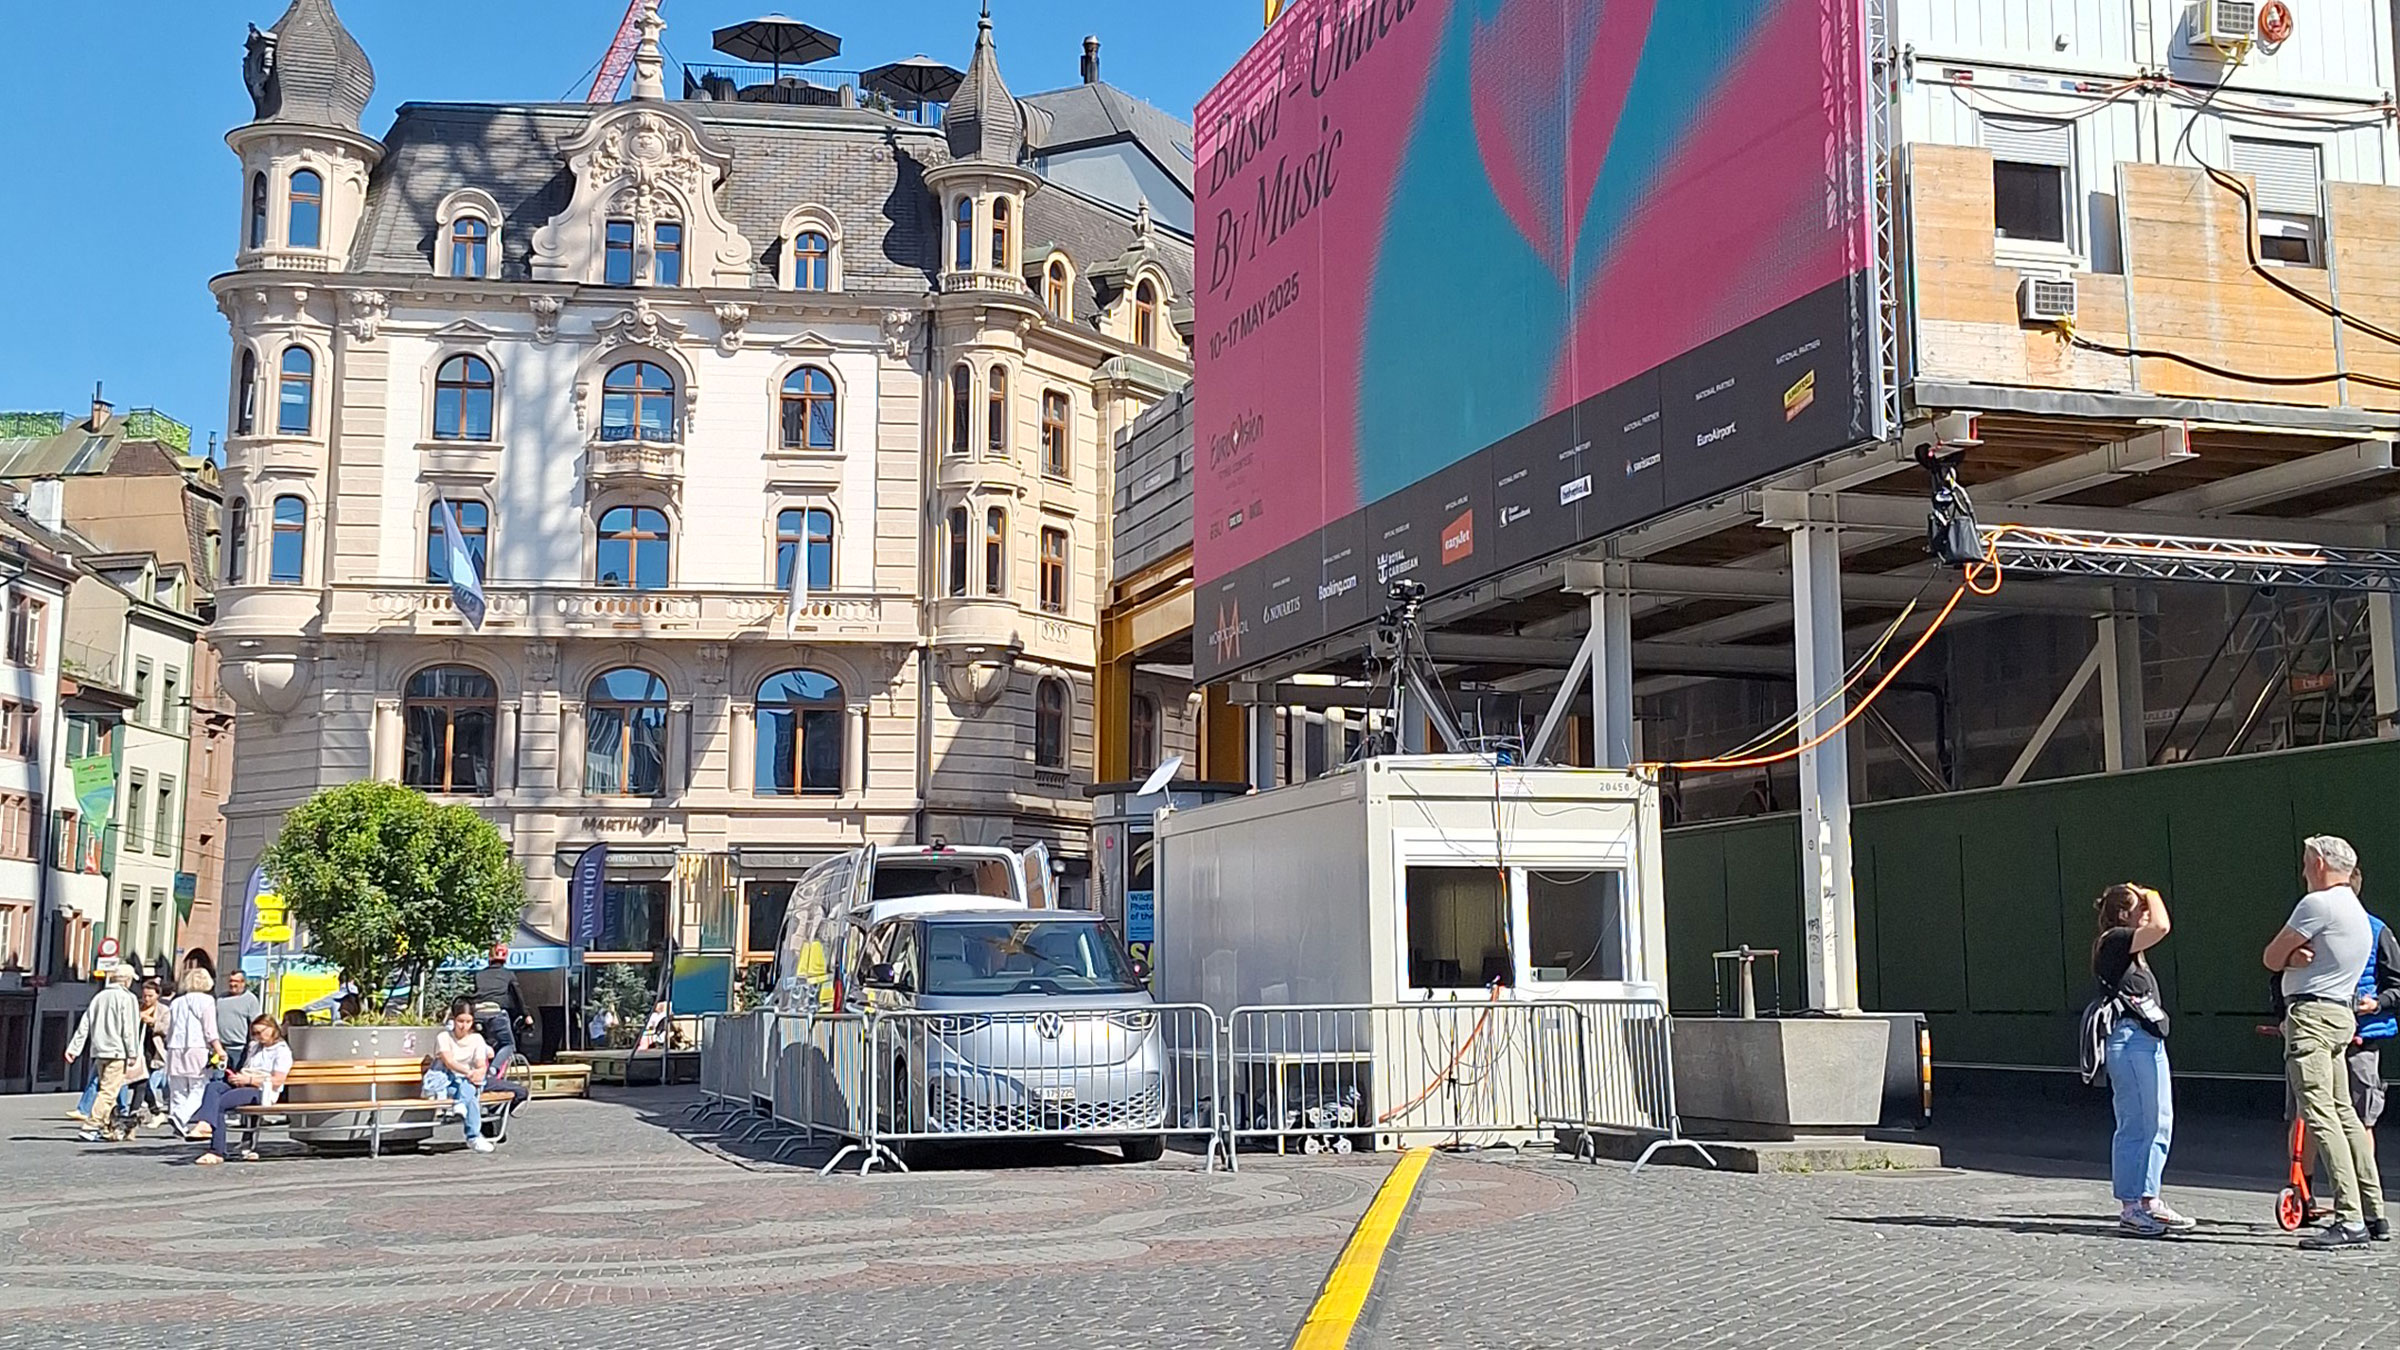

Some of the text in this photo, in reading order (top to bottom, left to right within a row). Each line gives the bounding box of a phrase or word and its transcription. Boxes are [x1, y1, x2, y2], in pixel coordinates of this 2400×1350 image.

[1208, 49, 1285, 199] Basel
[1310, 0, 1416, 98] Unite
[1208, 114, 1342, 302] By Music
[1209, 271, 1300, 361] 10-17 MAY 2025
[1696, 421, 1737, 447] EuroAirport
[1318, 574, 1358, 601] Booking.com
[581, 816, 663, 833] MARTHOF
